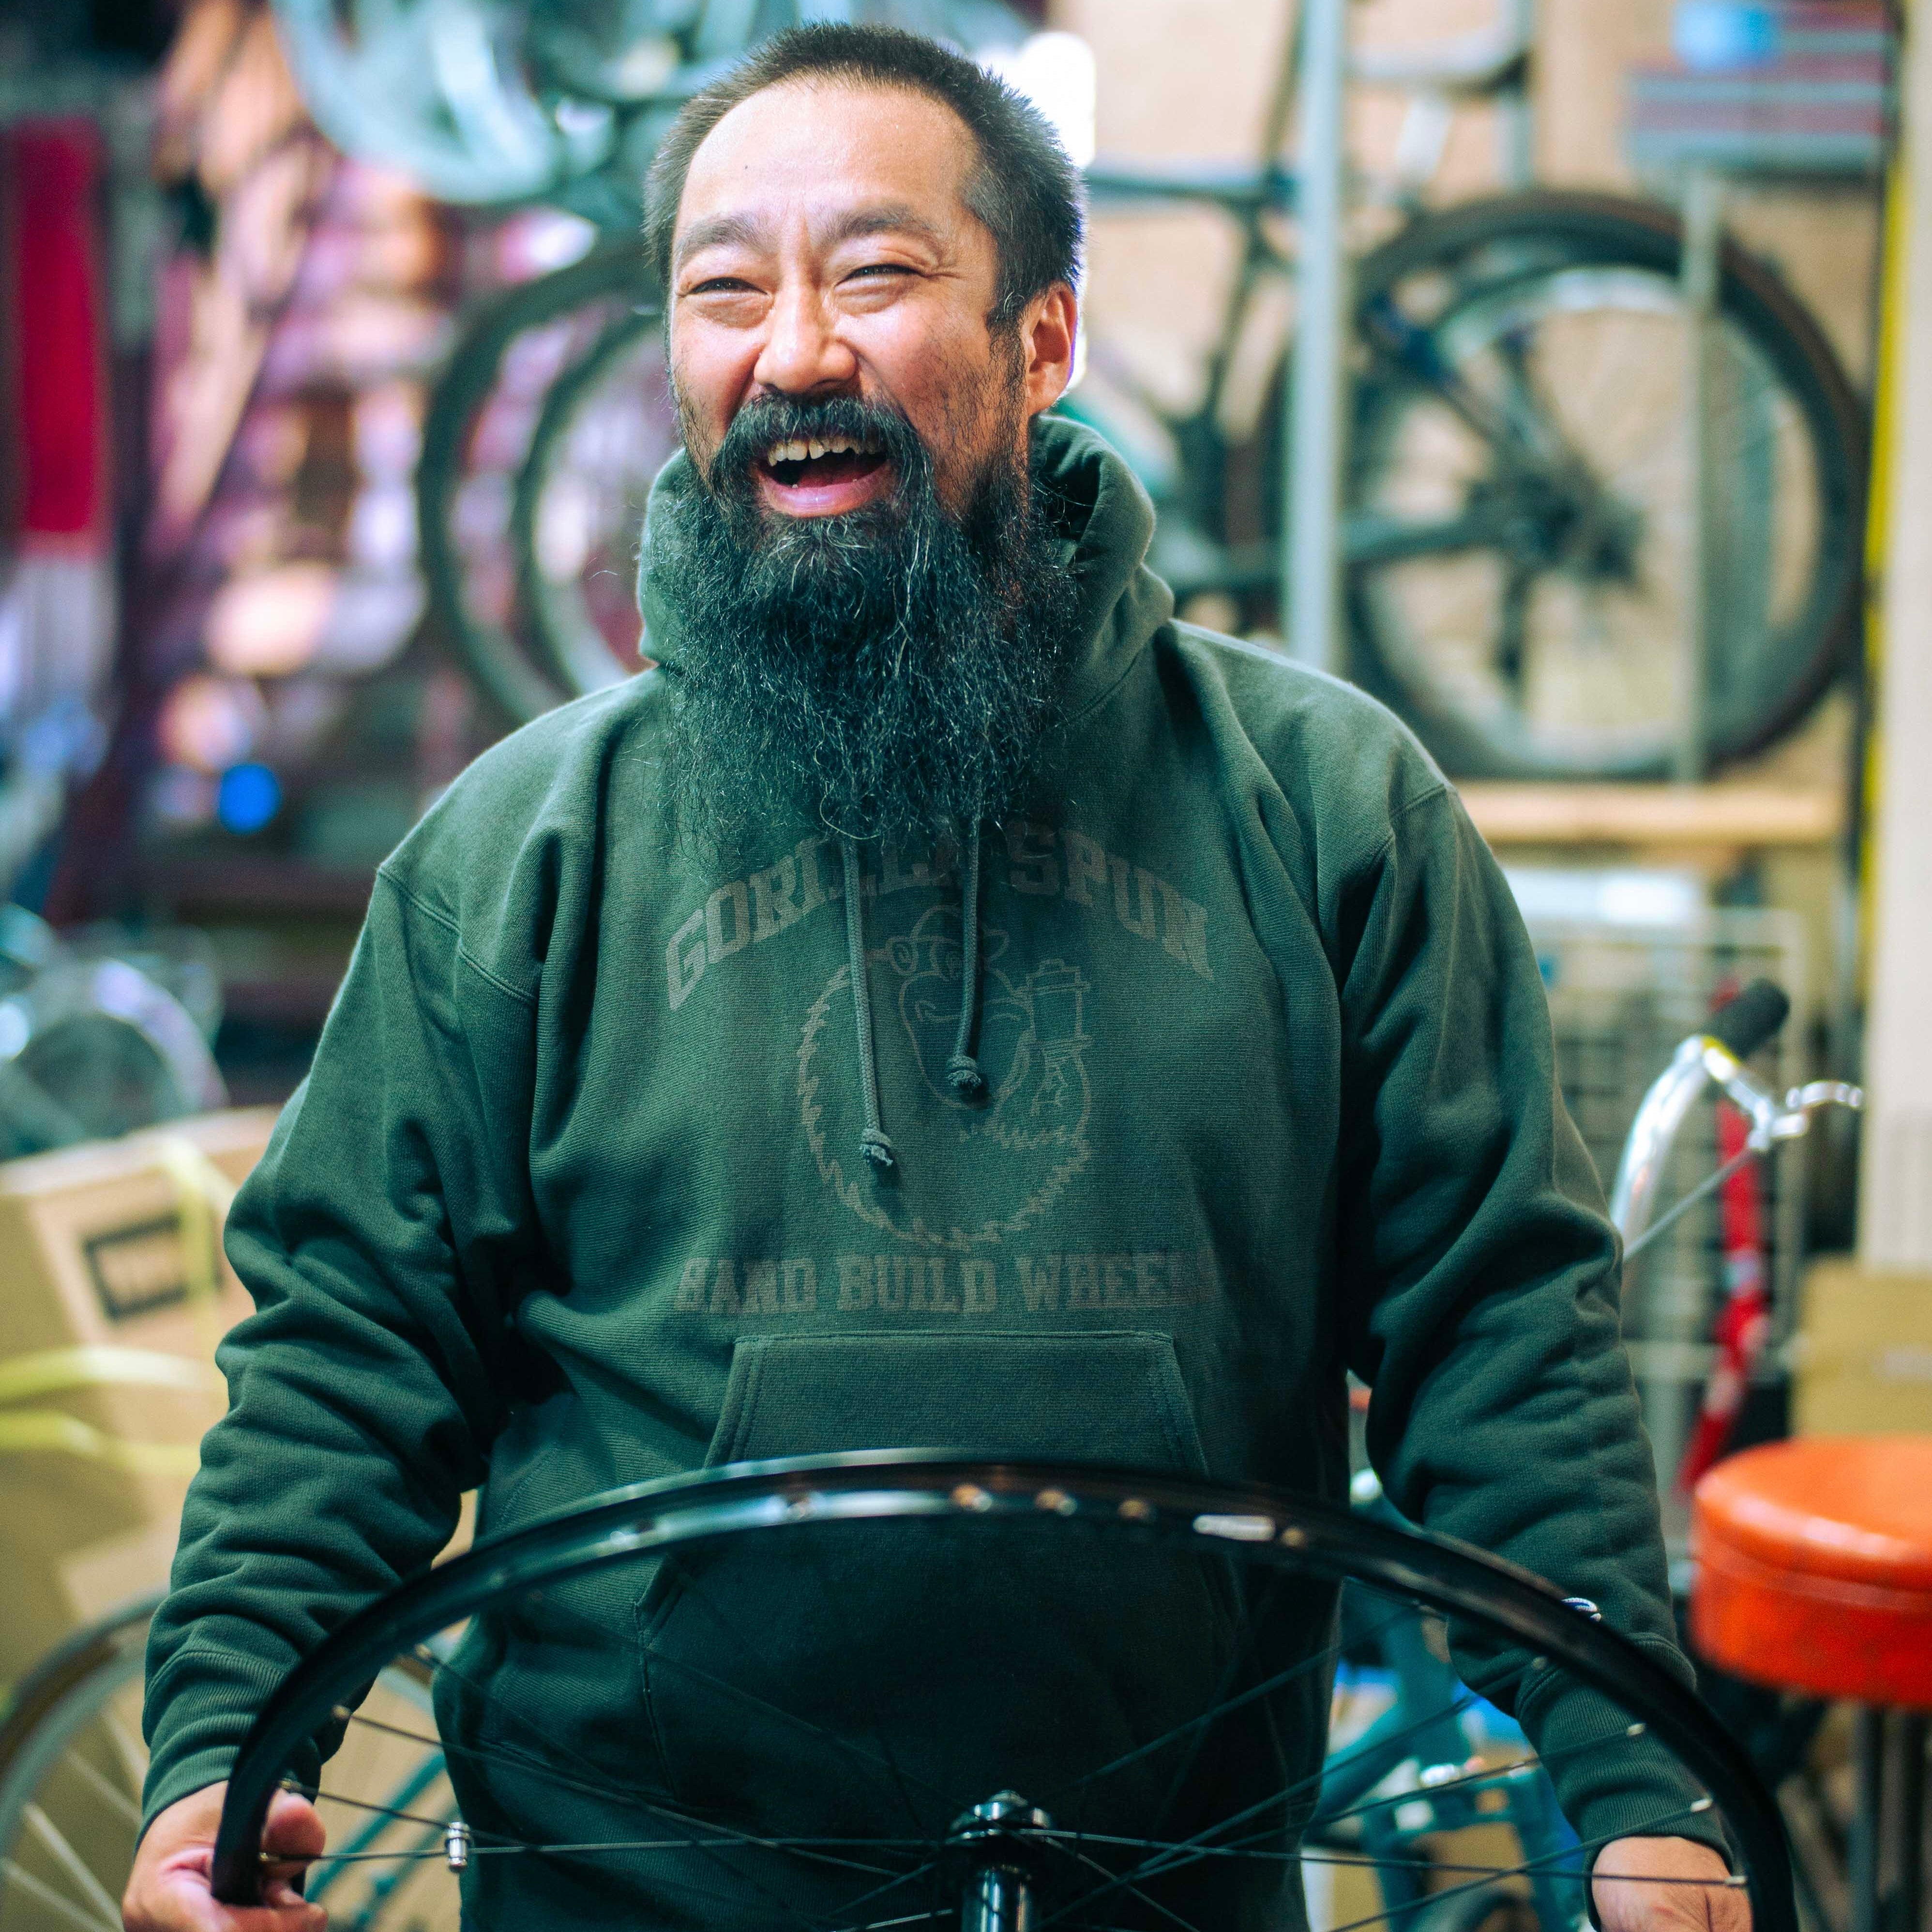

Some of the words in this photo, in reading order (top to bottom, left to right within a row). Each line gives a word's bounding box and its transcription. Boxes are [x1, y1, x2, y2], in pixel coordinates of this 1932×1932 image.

[1006, 821, 1215, 982] SPUN
[674, 1256, 816, 1314] HAND
[836, 1253, 997, 1313] BUILD
